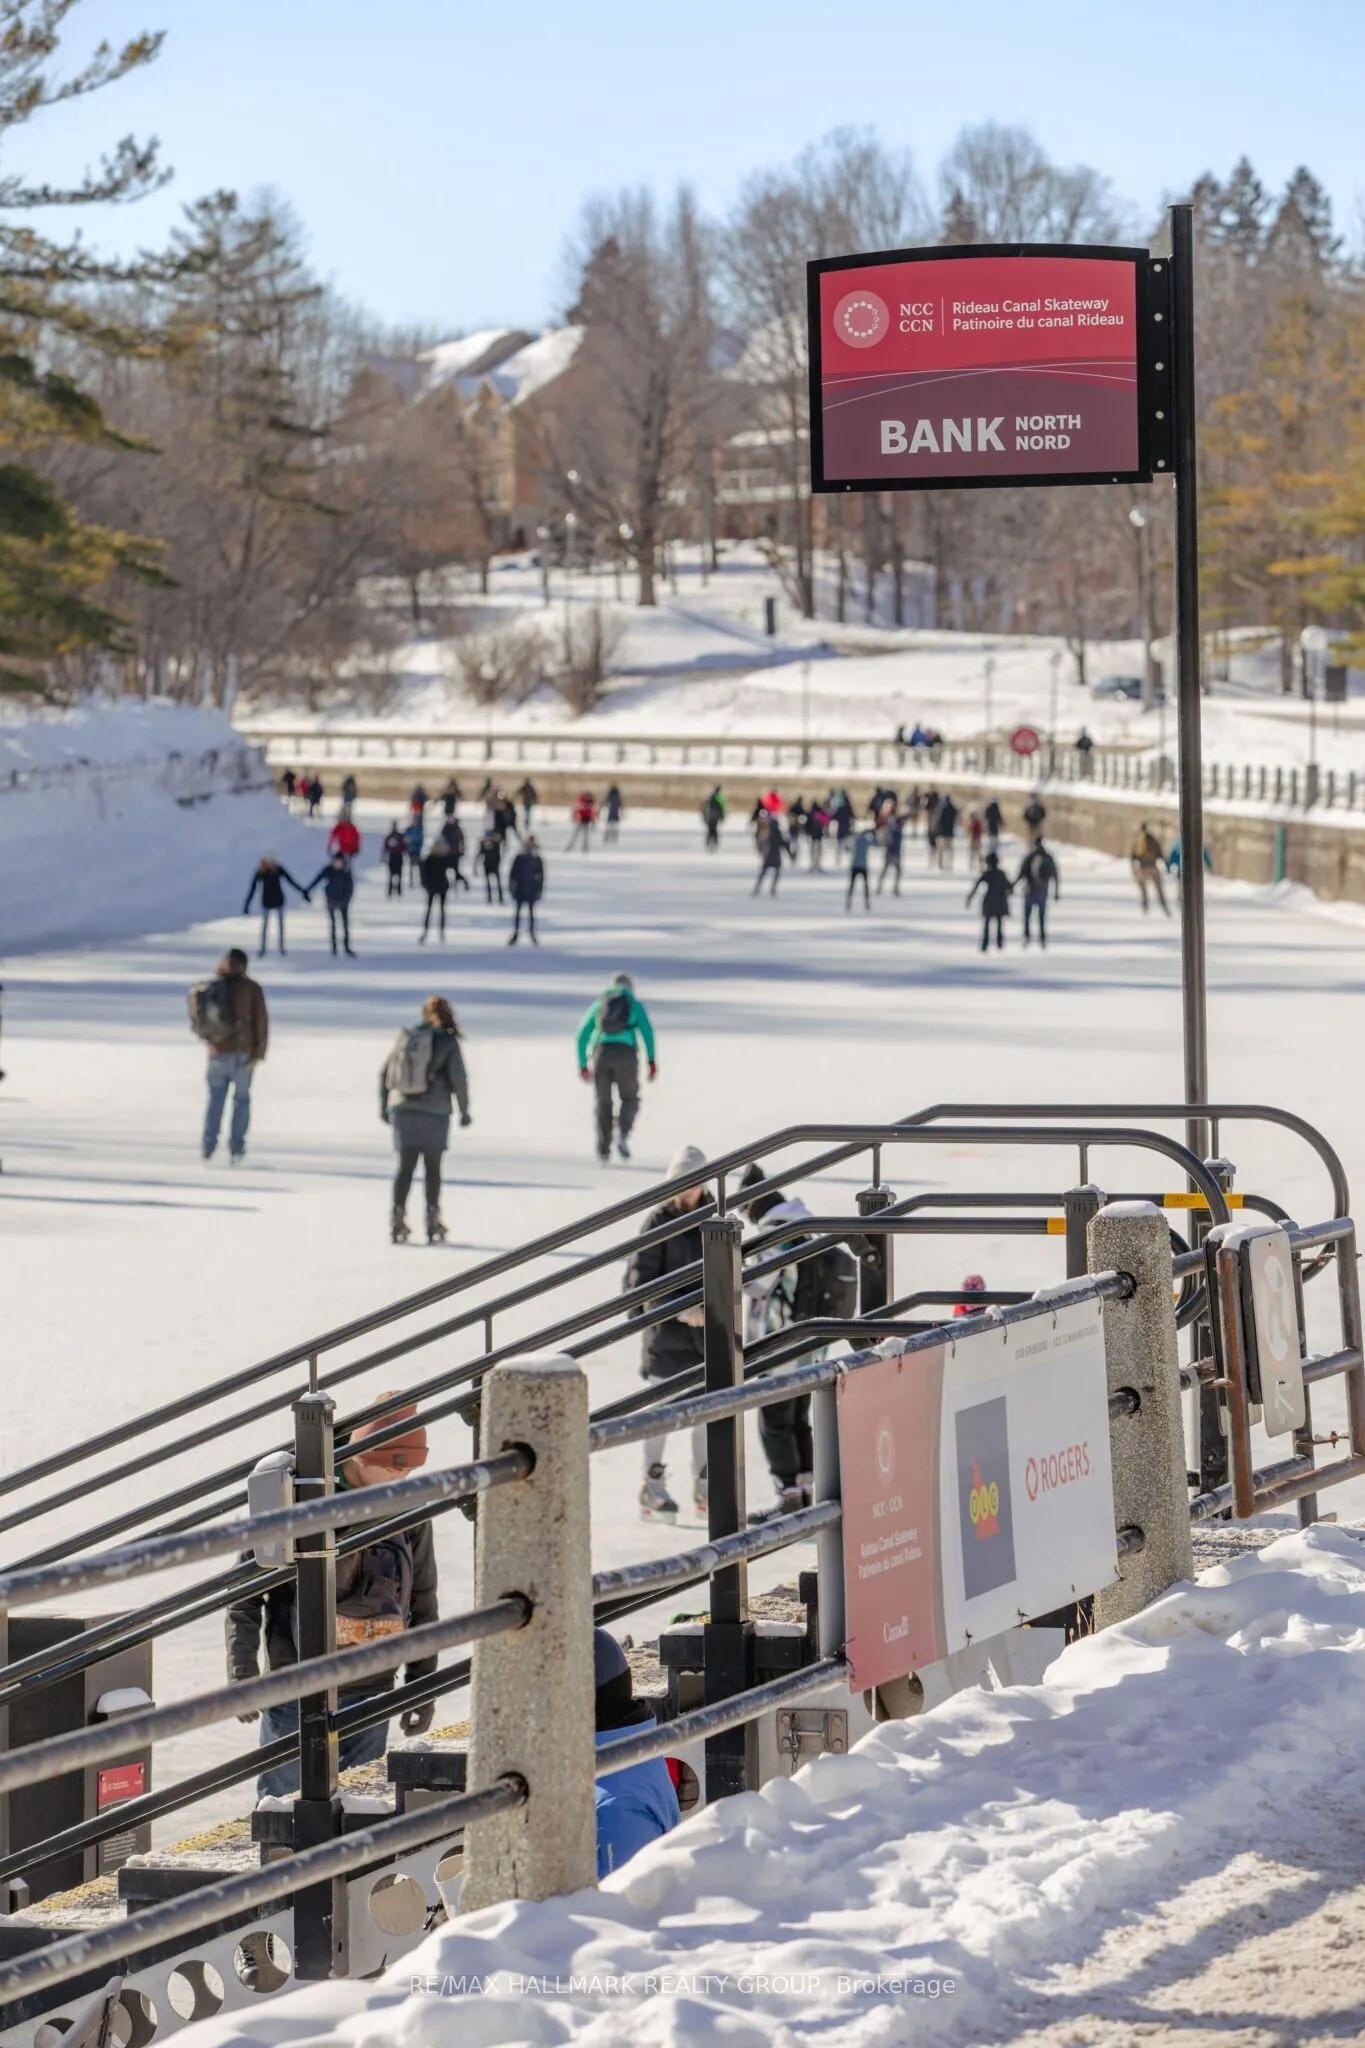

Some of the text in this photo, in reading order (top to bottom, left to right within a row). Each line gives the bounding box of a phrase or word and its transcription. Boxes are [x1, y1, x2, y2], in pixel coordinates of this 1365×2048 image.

[899, 302, 934, 317] NCC
[952, 297, 1109, 315] Rideau Canal Skateway
[899, 318, 934, 333] CCN
[952, 312, 1124, 331] Patinoire du canal Rideau
[1015, 414, 1082, 432] NORTH
[880, 416, 1006, 455] BANK
[1015, 434, 1071, 451] NORD
[1040, 1441, 1090, 1492] ROGERS
